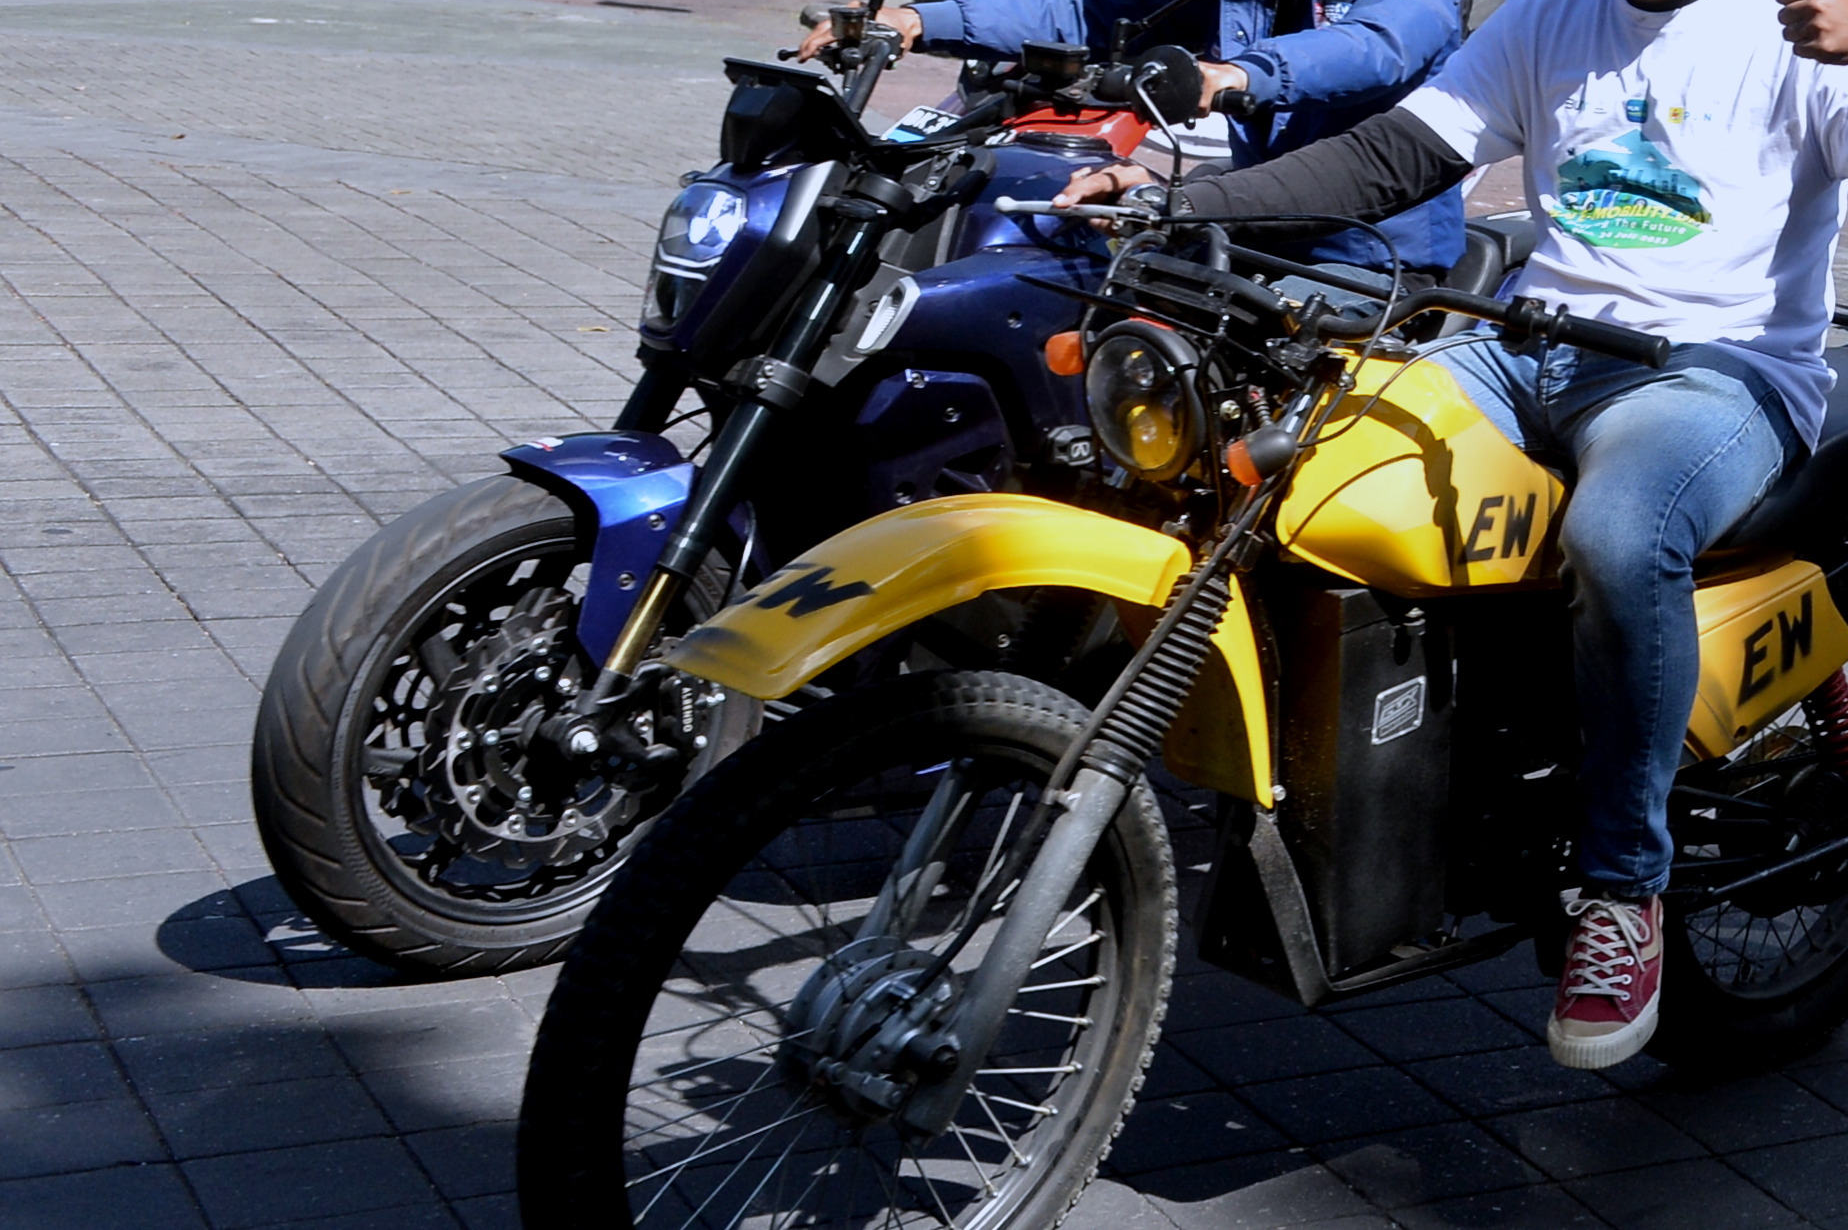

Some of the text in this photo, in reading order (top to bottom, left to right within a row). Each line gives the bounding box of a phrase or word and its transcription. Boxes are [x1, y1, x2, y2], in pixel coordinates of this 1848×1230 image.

[1615, 218, 1638, 229] The
[1641, 219, 1687, 235] Future
[1465, 492, 1537, 563] EW
[1737, 590, 1813, 707] EW
